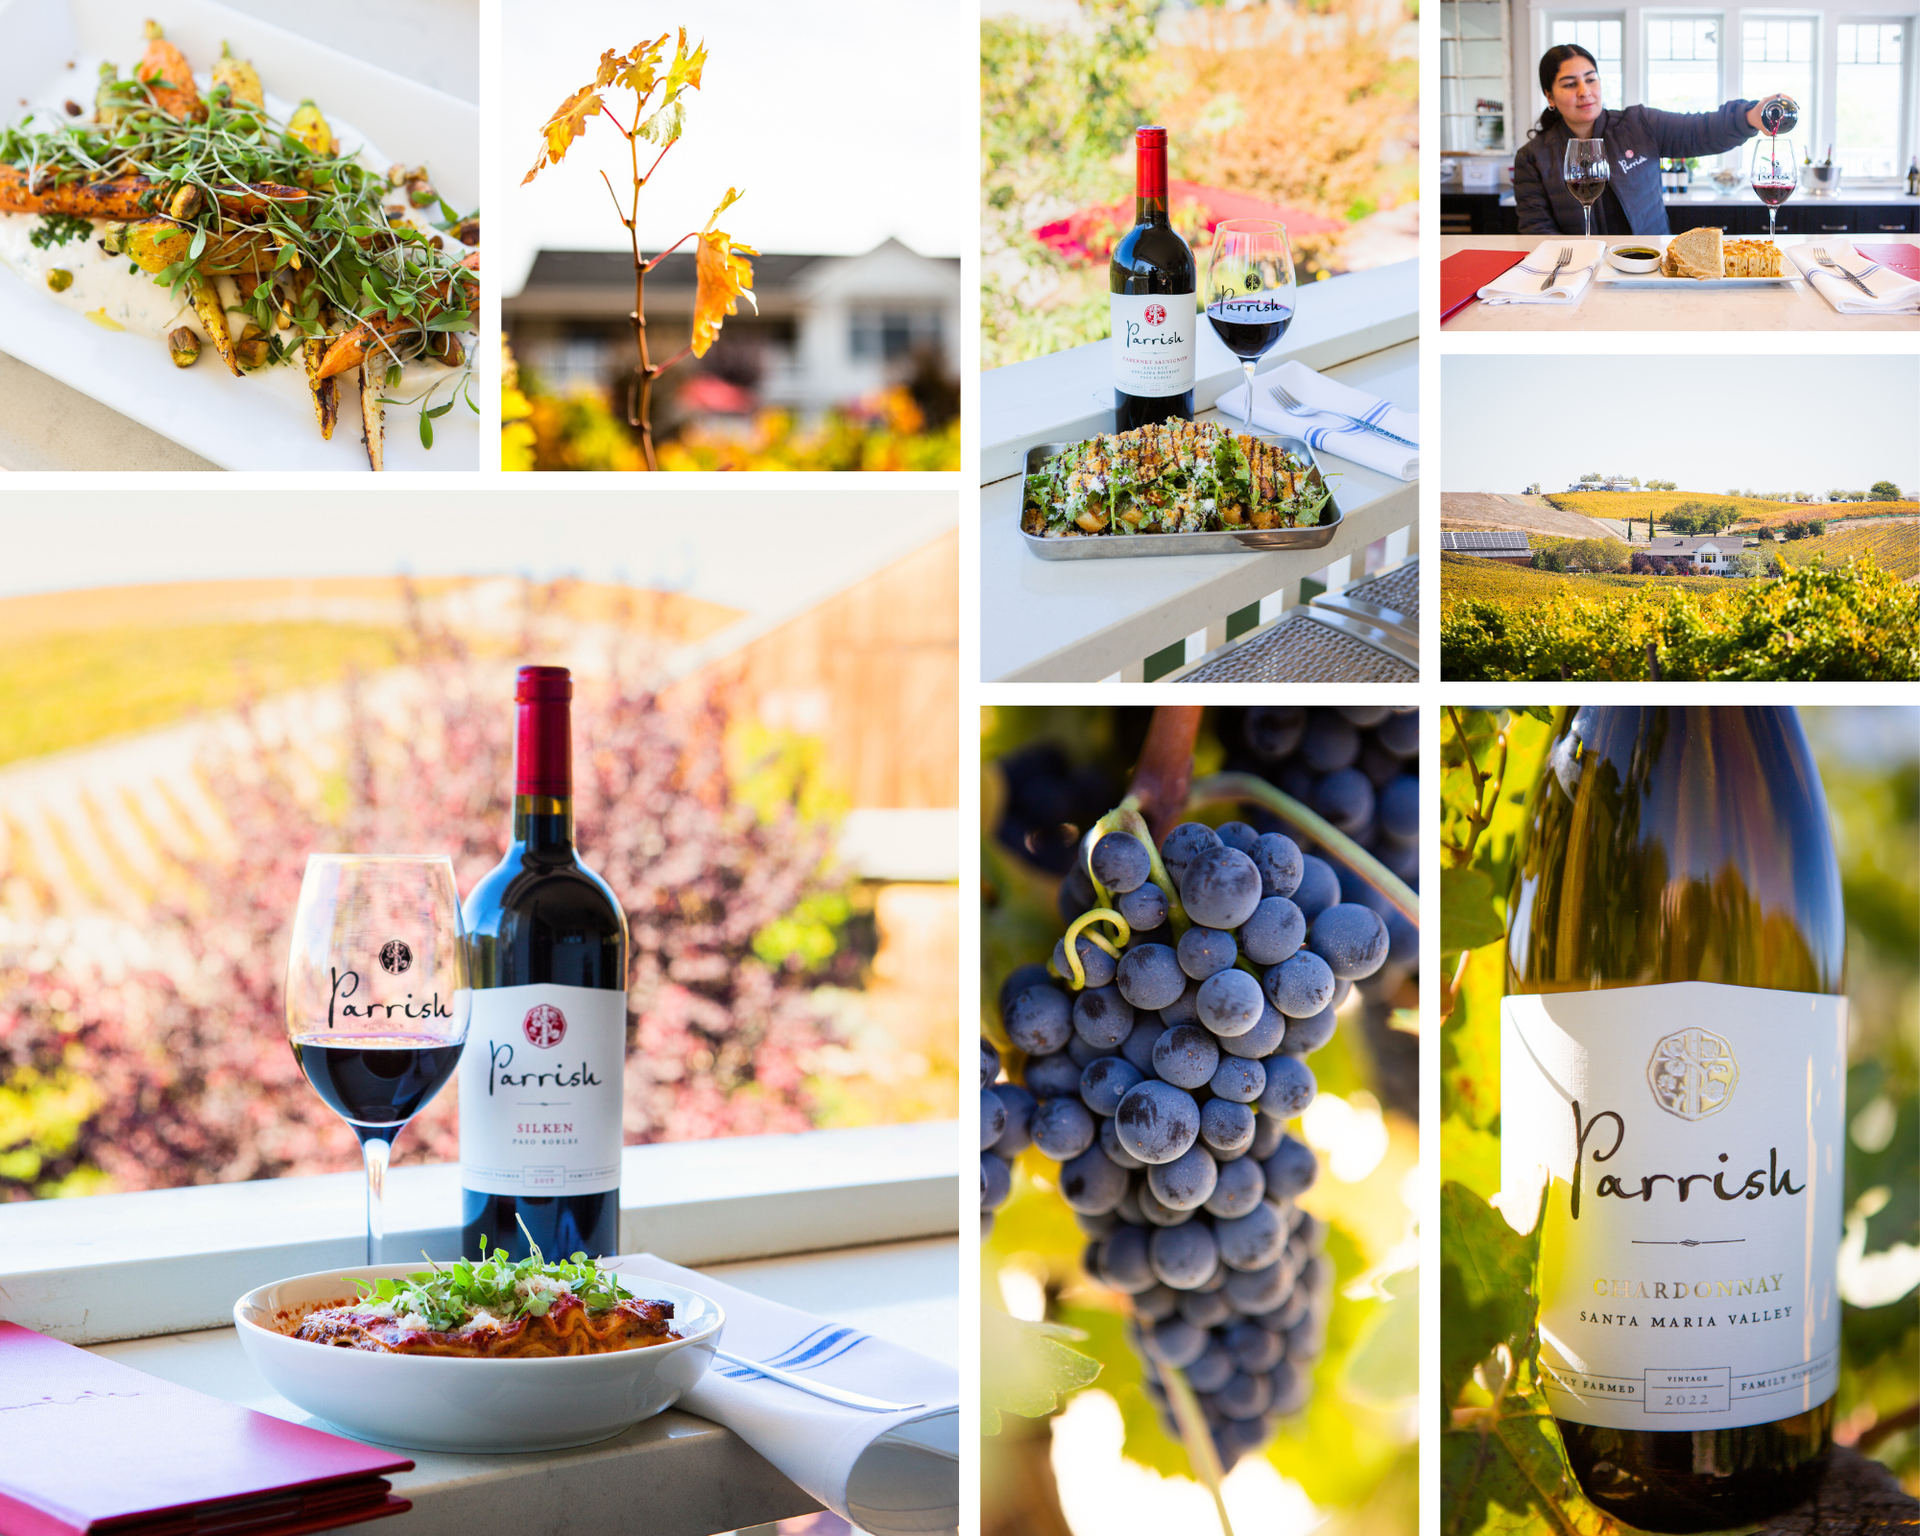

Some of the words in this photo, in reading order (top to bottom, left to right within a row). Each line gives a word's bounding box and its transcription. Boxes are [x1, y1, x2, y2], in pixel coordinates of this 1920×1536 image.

[1219, 284, 1283, 315] Parrish
[1126, 319, 1185, 349] Parrish
[1122, 356, 1153, 365] CABERNET
[1154, 355, 1188, 365] SAUVIGNON
[328, 966, 453, 1029] Parrish
[488, 1039, 602, 1097] Parrish
[516, 1123, 573, 1134] SILKEN
[1570, 1099, 1806, 1220] Parrish
[1593, 1273, 1784, 1299] CHARDONNAY
[1580, 1310, 1639, 1327] SANTA
[1650, 1316, 1717, 1328] MARIA
[1728, 1306, 1793, 1325] VALLEY
[1583, 1380, 1635, 1394] FARMED
[1667, 1375, 1708, 1383] VINTAGE
[1741, 1375, 1787, 1391] FAMILY
[1664, 1394, 1709, 1406] 2022
